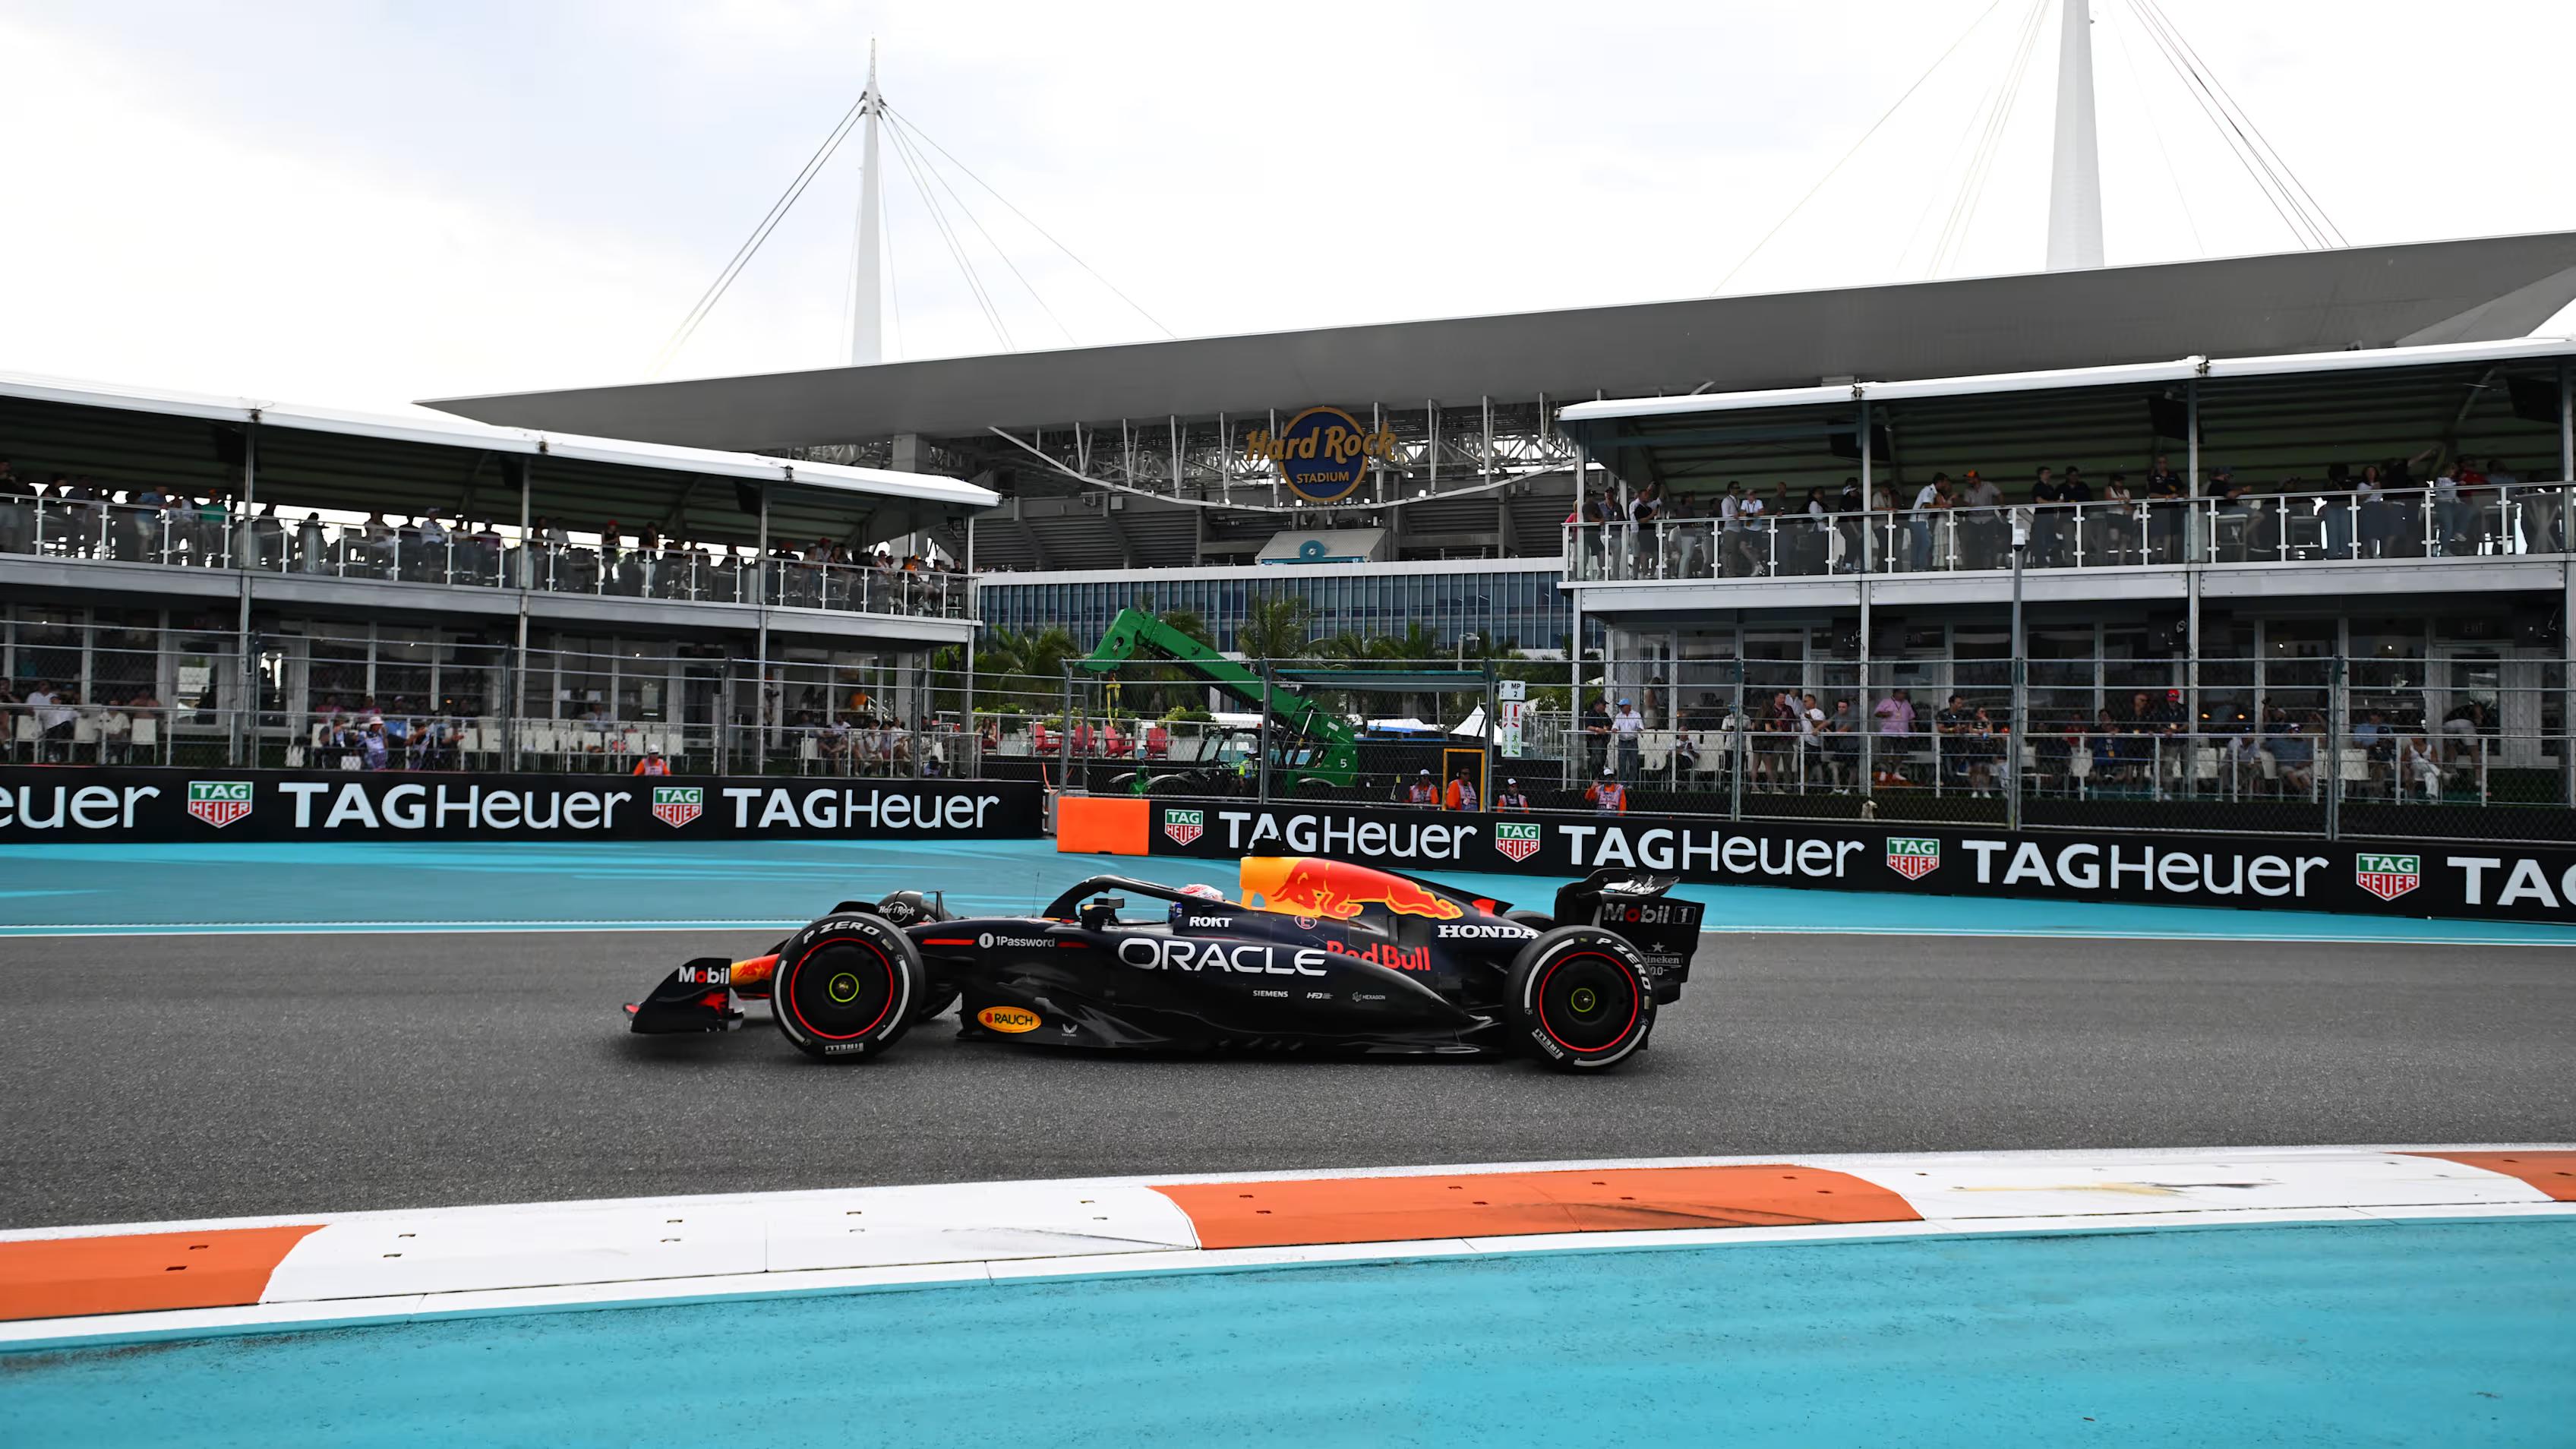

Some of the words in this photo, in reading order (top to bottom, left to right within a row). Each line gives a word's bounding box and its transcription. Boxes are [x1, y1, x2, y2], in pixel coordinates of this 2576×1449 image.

[1246, 427, 1320, 462] Hard
[1324, 421, 1397, 464] Rock
[1296, 472, 1350, 484] STADIUM
[1340, 759, 1347, 769] 5
[194, 784, 247, 799] TAG
[658, 790, 698, 802] TAG
[0, 786, 160, 829] uer
[192, 803, 248, 824] HEUER
[656, 806, 699, 825] HEUER
[1168, 812, 1199, 824] TAG
[1167, 826, 1201, 843] HEUER
[1500, 826, 1536, 838] TAG
[1498, 840, 1537, 859] HEUER
[1891, 840, 1935, 854] TAG
[1890, 856, 1937, 876] HEUER
[2362, 857, 2413, 872] TAG
[2360, 874, 2416, 897] HEUER
[2447, 857, 2576, 907] TA
[1189, 916, 1233, 927] ROKT
[1604, 903, 1670, 923] Mobil
[803, 930, 815, 944] P
[819, 920, 880, 936] ZERO
[1438, 924, 1539, 939] HONDA
[996, 936, 1055, 948] 1Password
[1119, 937, 1327, 976] ORACLE
[1644, 955, 1679, 964] eineken
[678, 966, 730, 984] Mobil
[1612, 943, 1652, 990] ZERO
[994, 1013, 1033, 1026] RAUCH
[1532, 1028, 1564, 1060] PIRELLI
